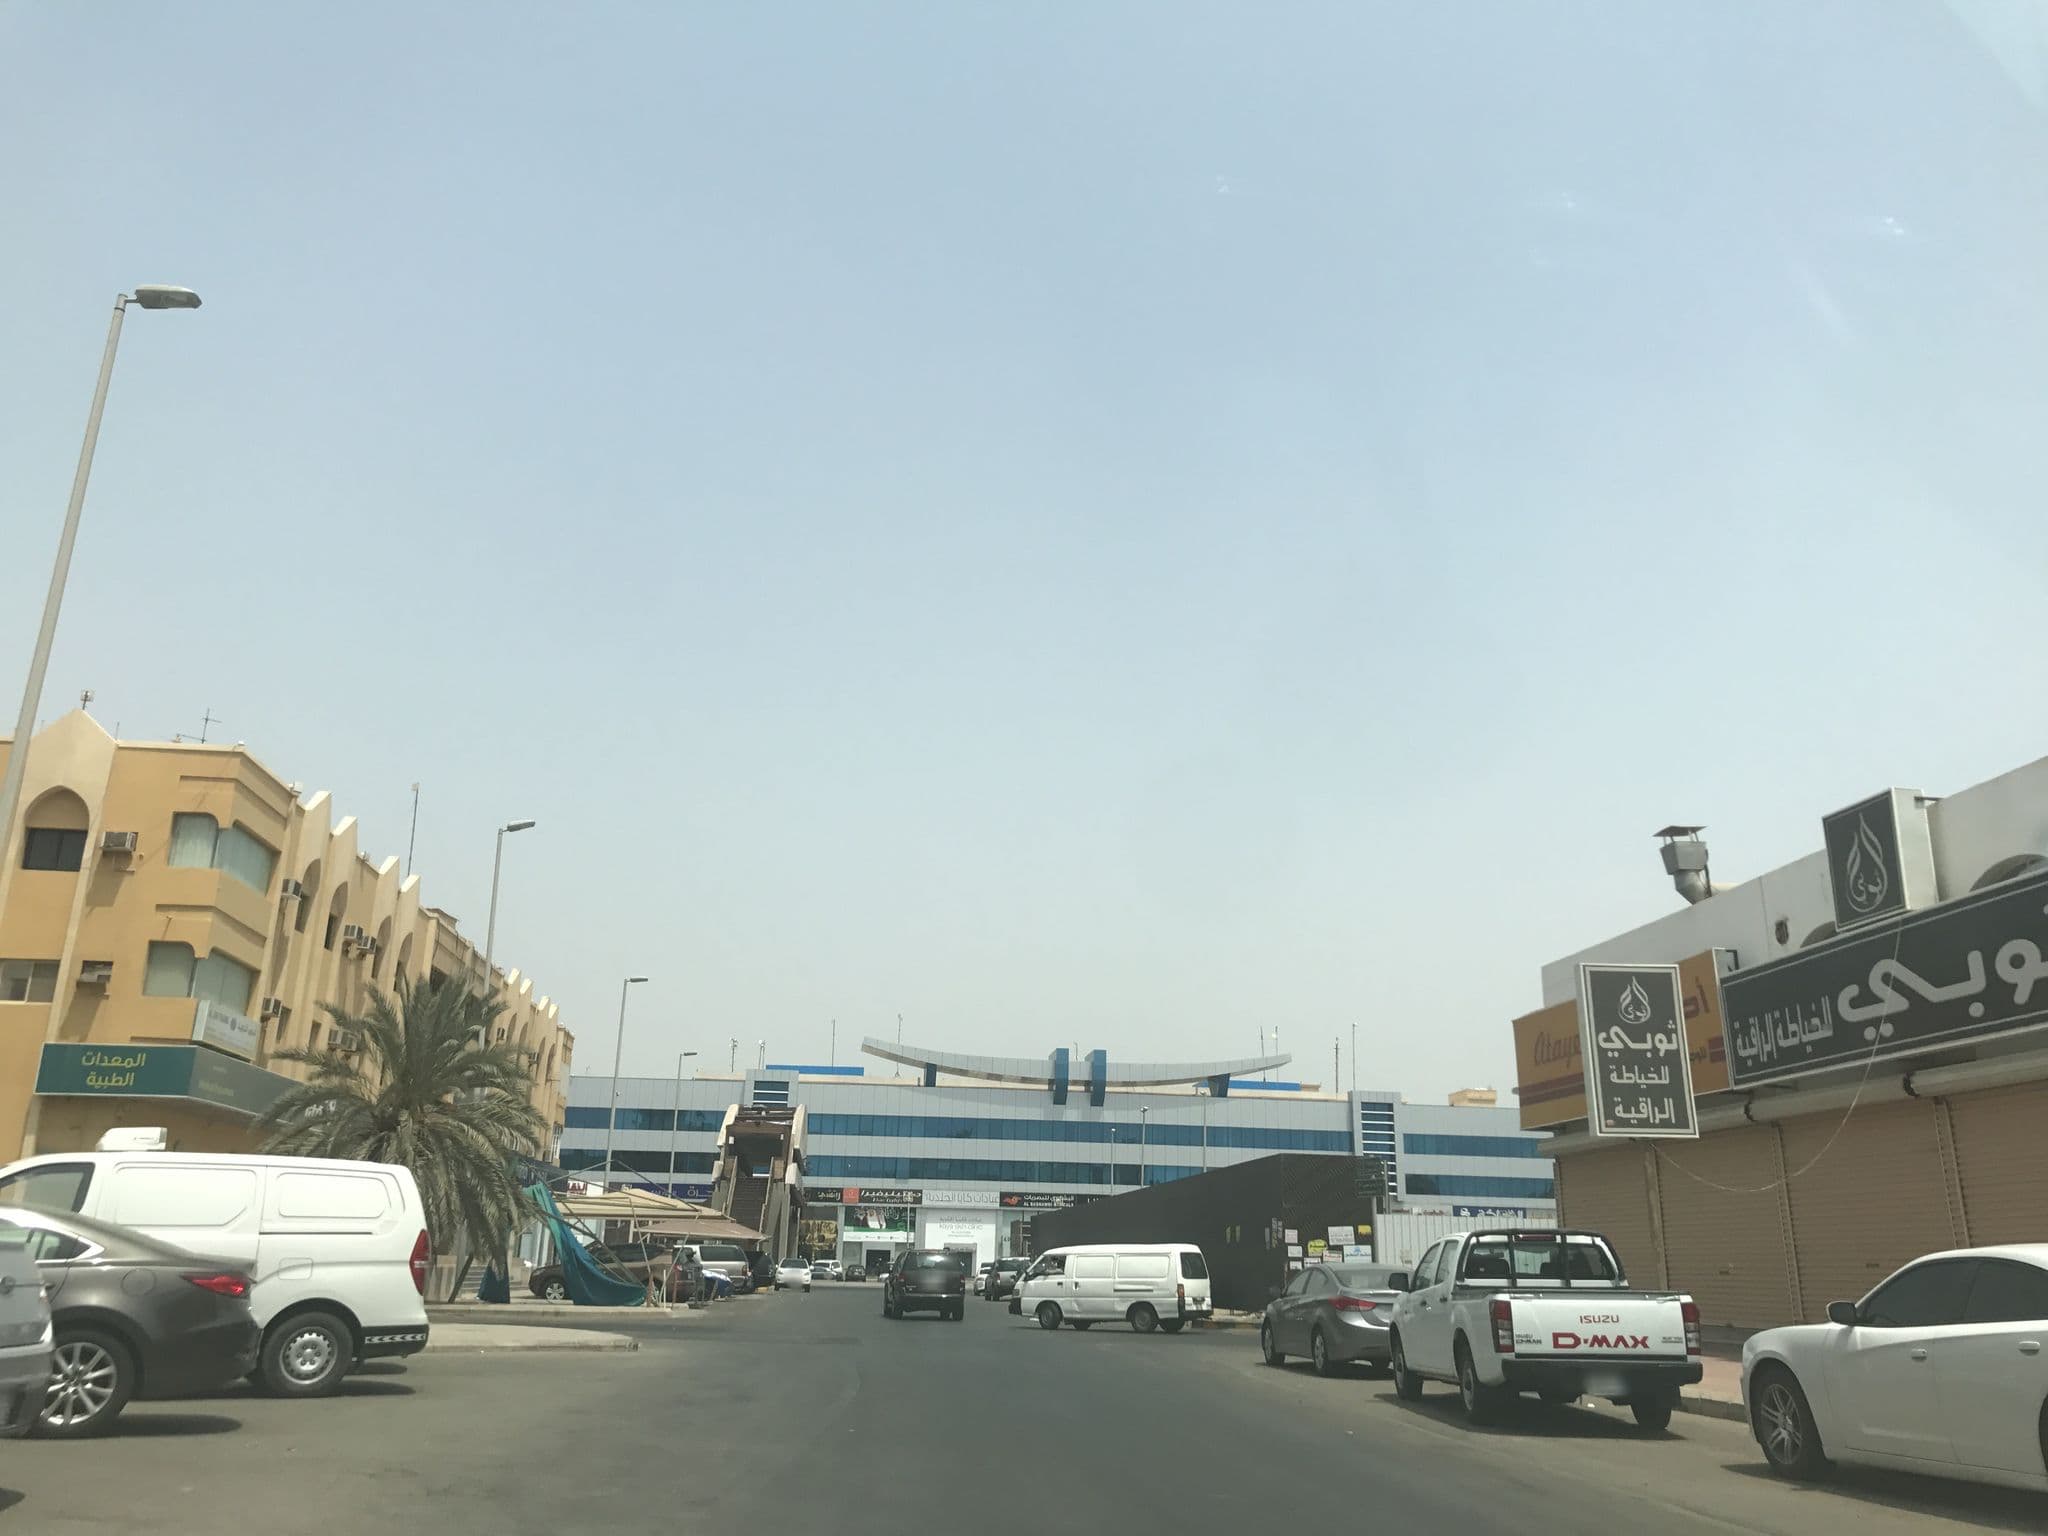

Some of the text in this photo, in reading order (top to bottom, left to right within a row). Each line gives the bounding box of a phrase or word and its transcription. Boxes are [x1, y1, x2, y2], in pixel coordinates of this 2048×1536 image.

[1837, 903, 2048, 1042] وبي
[1776, 994, 1834, 1054] للخياطة
[1598, 1020, 1678, 1057] ثوبي
[1735, 1013, 1777, 1065] الراقية
[81, 1052, 147, 1068] المعدات
[86, 1072, 135, 1089] الطبية
[1610, 1064, 1670, 1088] للخياطة
[1614, 1097, 1676, 1124] الراقية
[1580, 1314, 1620, 1324] ISUZU
